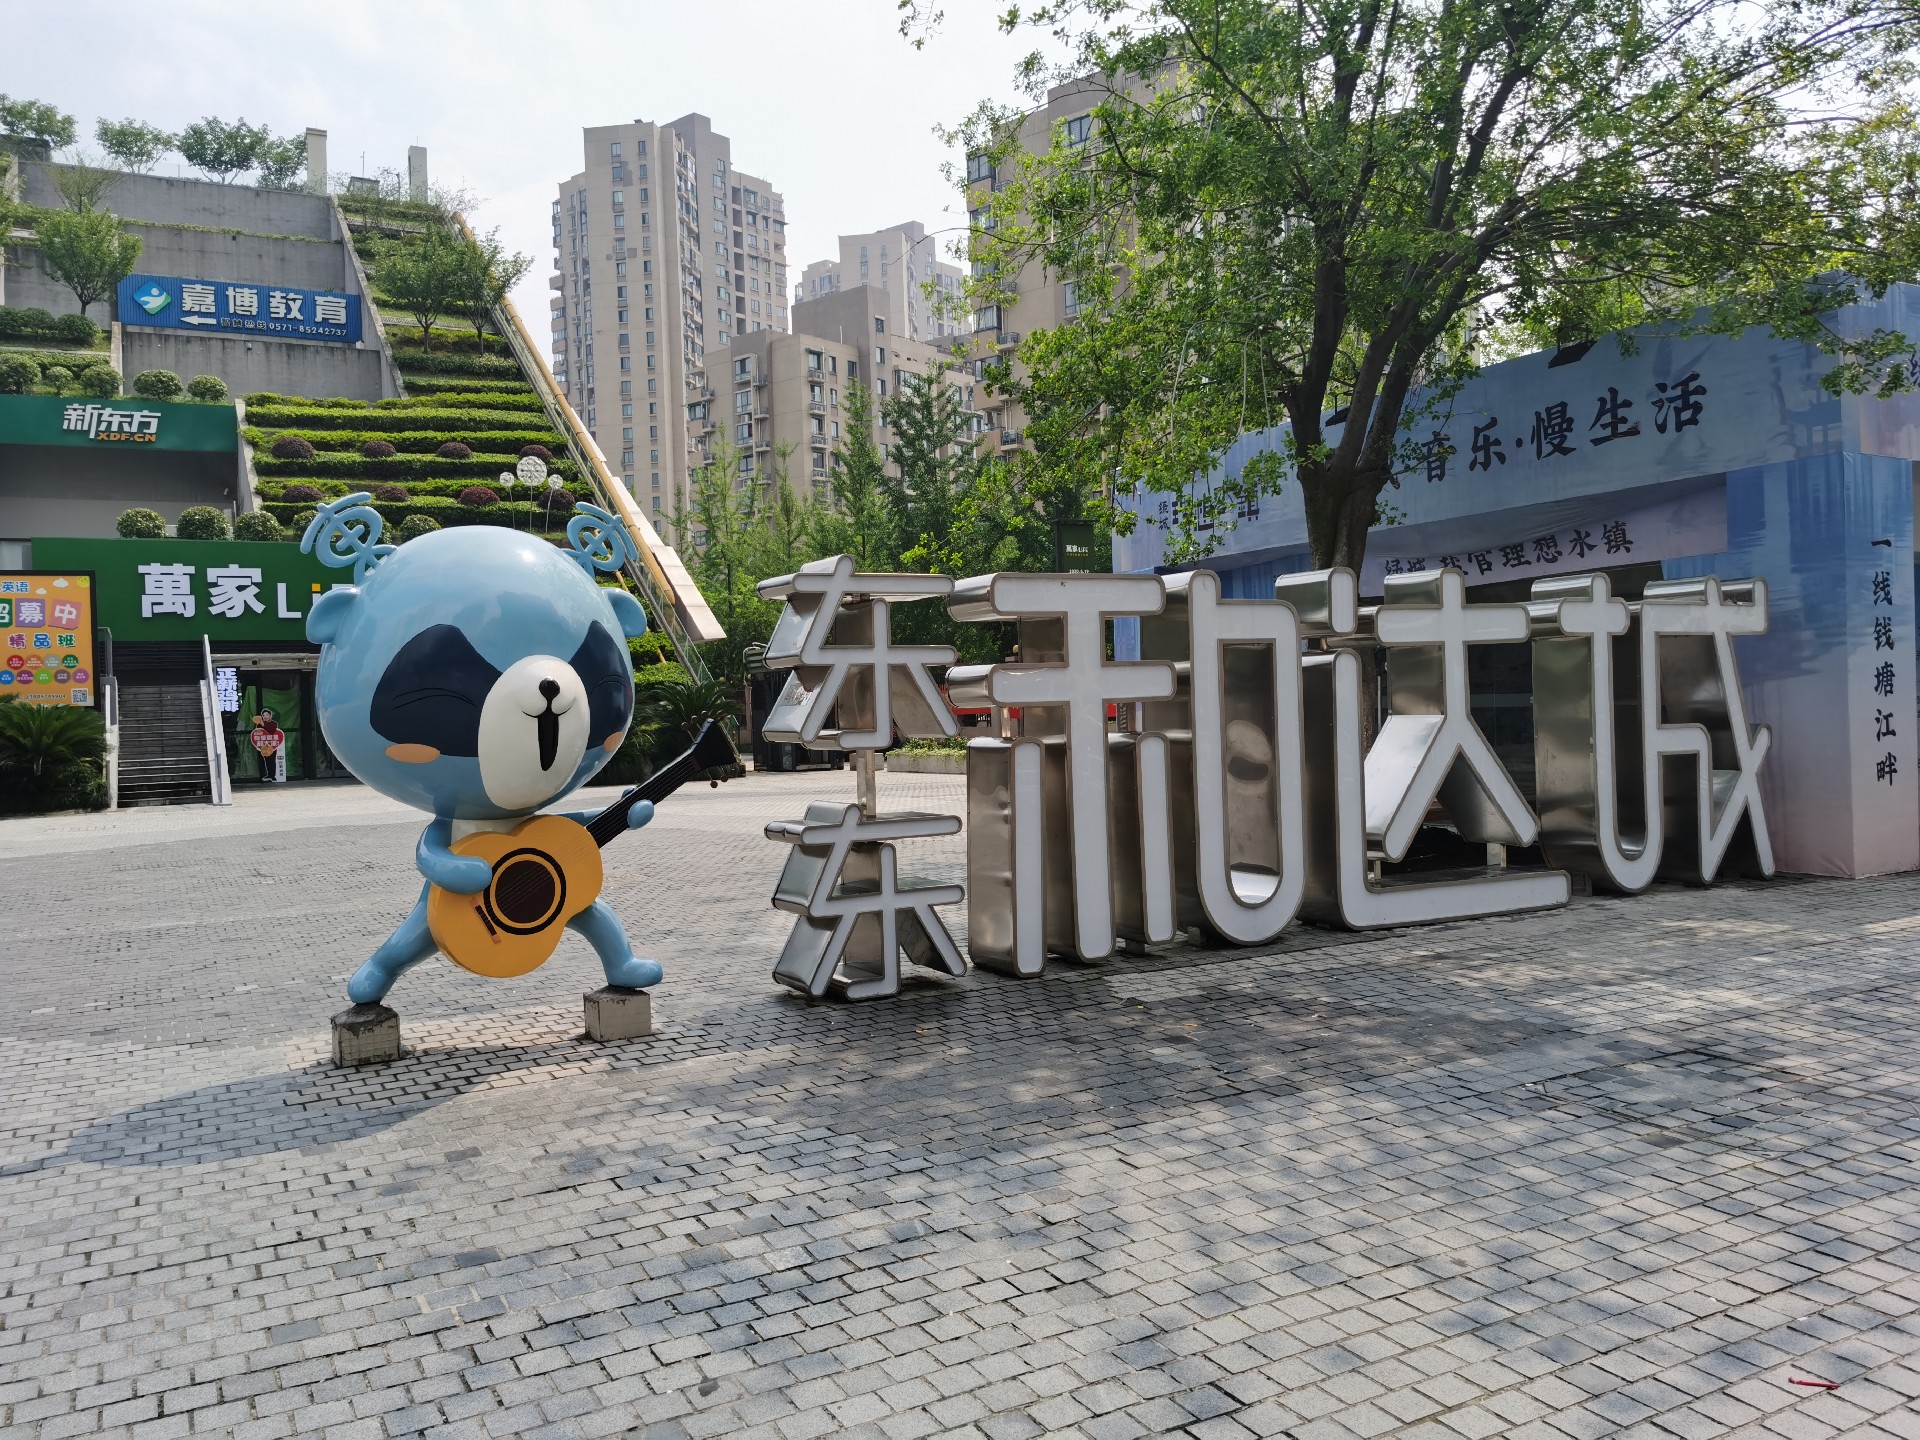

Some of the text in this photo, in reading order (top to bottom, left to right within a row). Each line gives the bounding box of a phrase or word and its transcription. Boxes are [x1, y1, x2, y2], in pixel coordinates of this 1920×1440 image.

[182, 283, 347, 325] 嘉博教育
[268, 322, 348, 337] 0571-85242737
[62, 403, 161, 439] 新东方
[97, 432, 156, 442] XDF.CN
[1389, 371, 1708, 490] 音乐·慢生活
[8, 633, 76, 649] 精品班
[1870, 538, 1899, 787] 一线钱塘江畔
[216, 667, 239, 713] 正新鸡排
